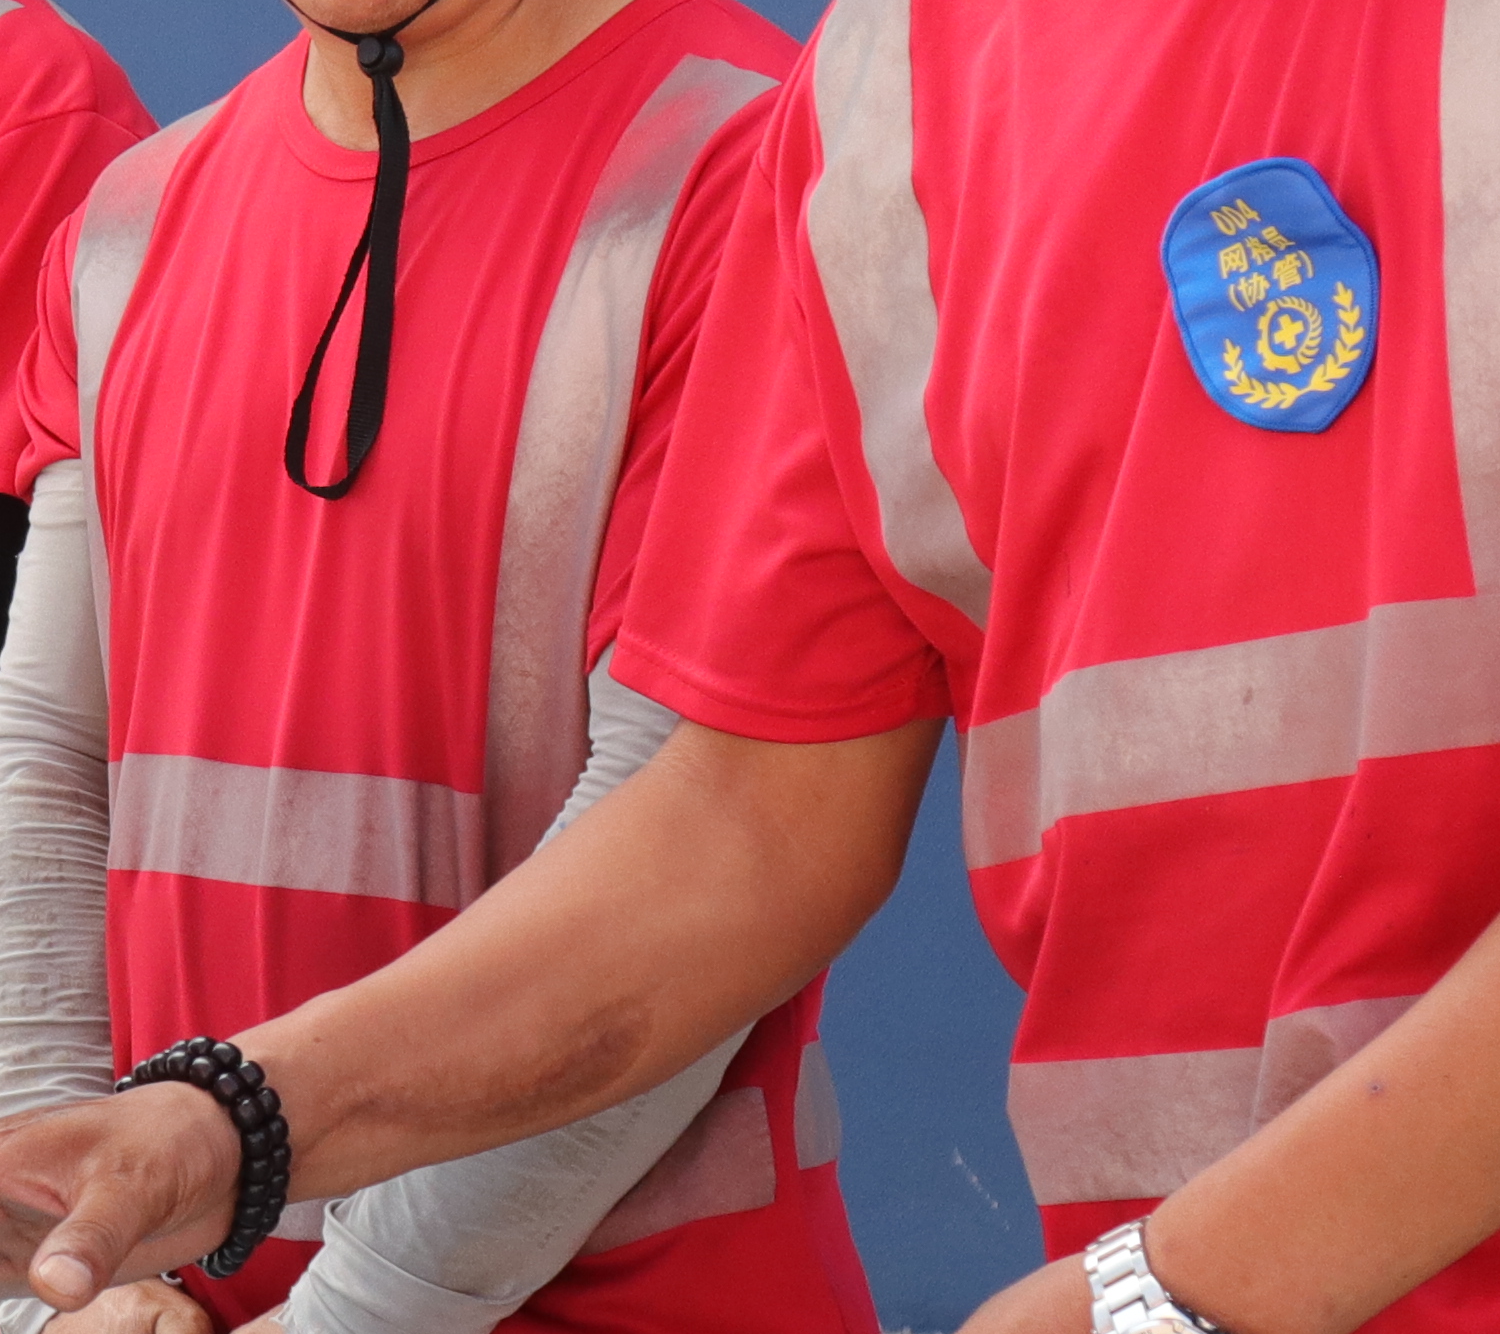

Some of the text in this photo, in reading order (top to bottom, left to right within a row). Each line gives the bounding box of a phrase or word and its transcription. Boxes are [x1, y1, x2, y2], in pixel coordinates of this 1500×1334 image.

[1209, 197, 1262, 236] 004
[1218, 225, 1297, 279] 网格员
